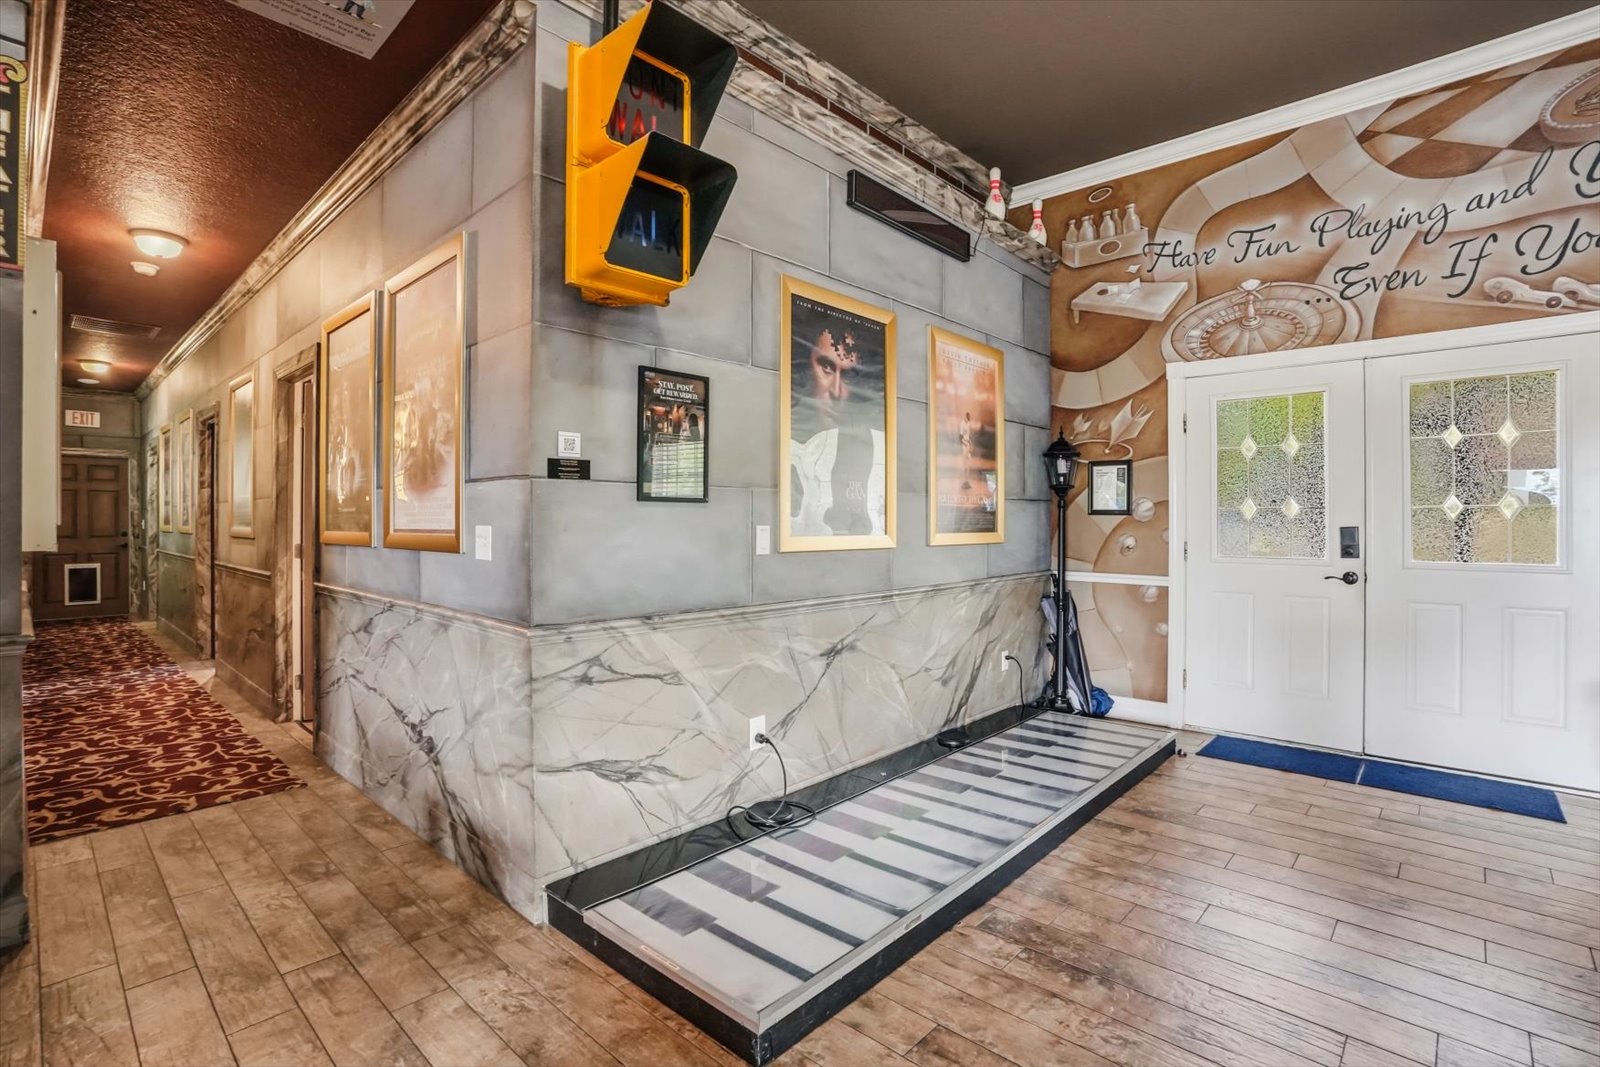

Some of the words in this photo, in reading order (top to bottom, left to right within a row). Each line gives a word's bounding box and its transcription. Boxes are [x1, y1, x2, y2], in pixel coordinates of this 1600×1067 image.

[610, 98, 657, 142] WAL
[1142, 240, 1218, 274] Have
[1226, 223, 1300, 264] Fun
[1310, 203, 1456, 255] Playing
[1465, 145, 1554, 213] and
[1440, 231, 1498, 299] If
[71, 411, 96, 426] EXIT
